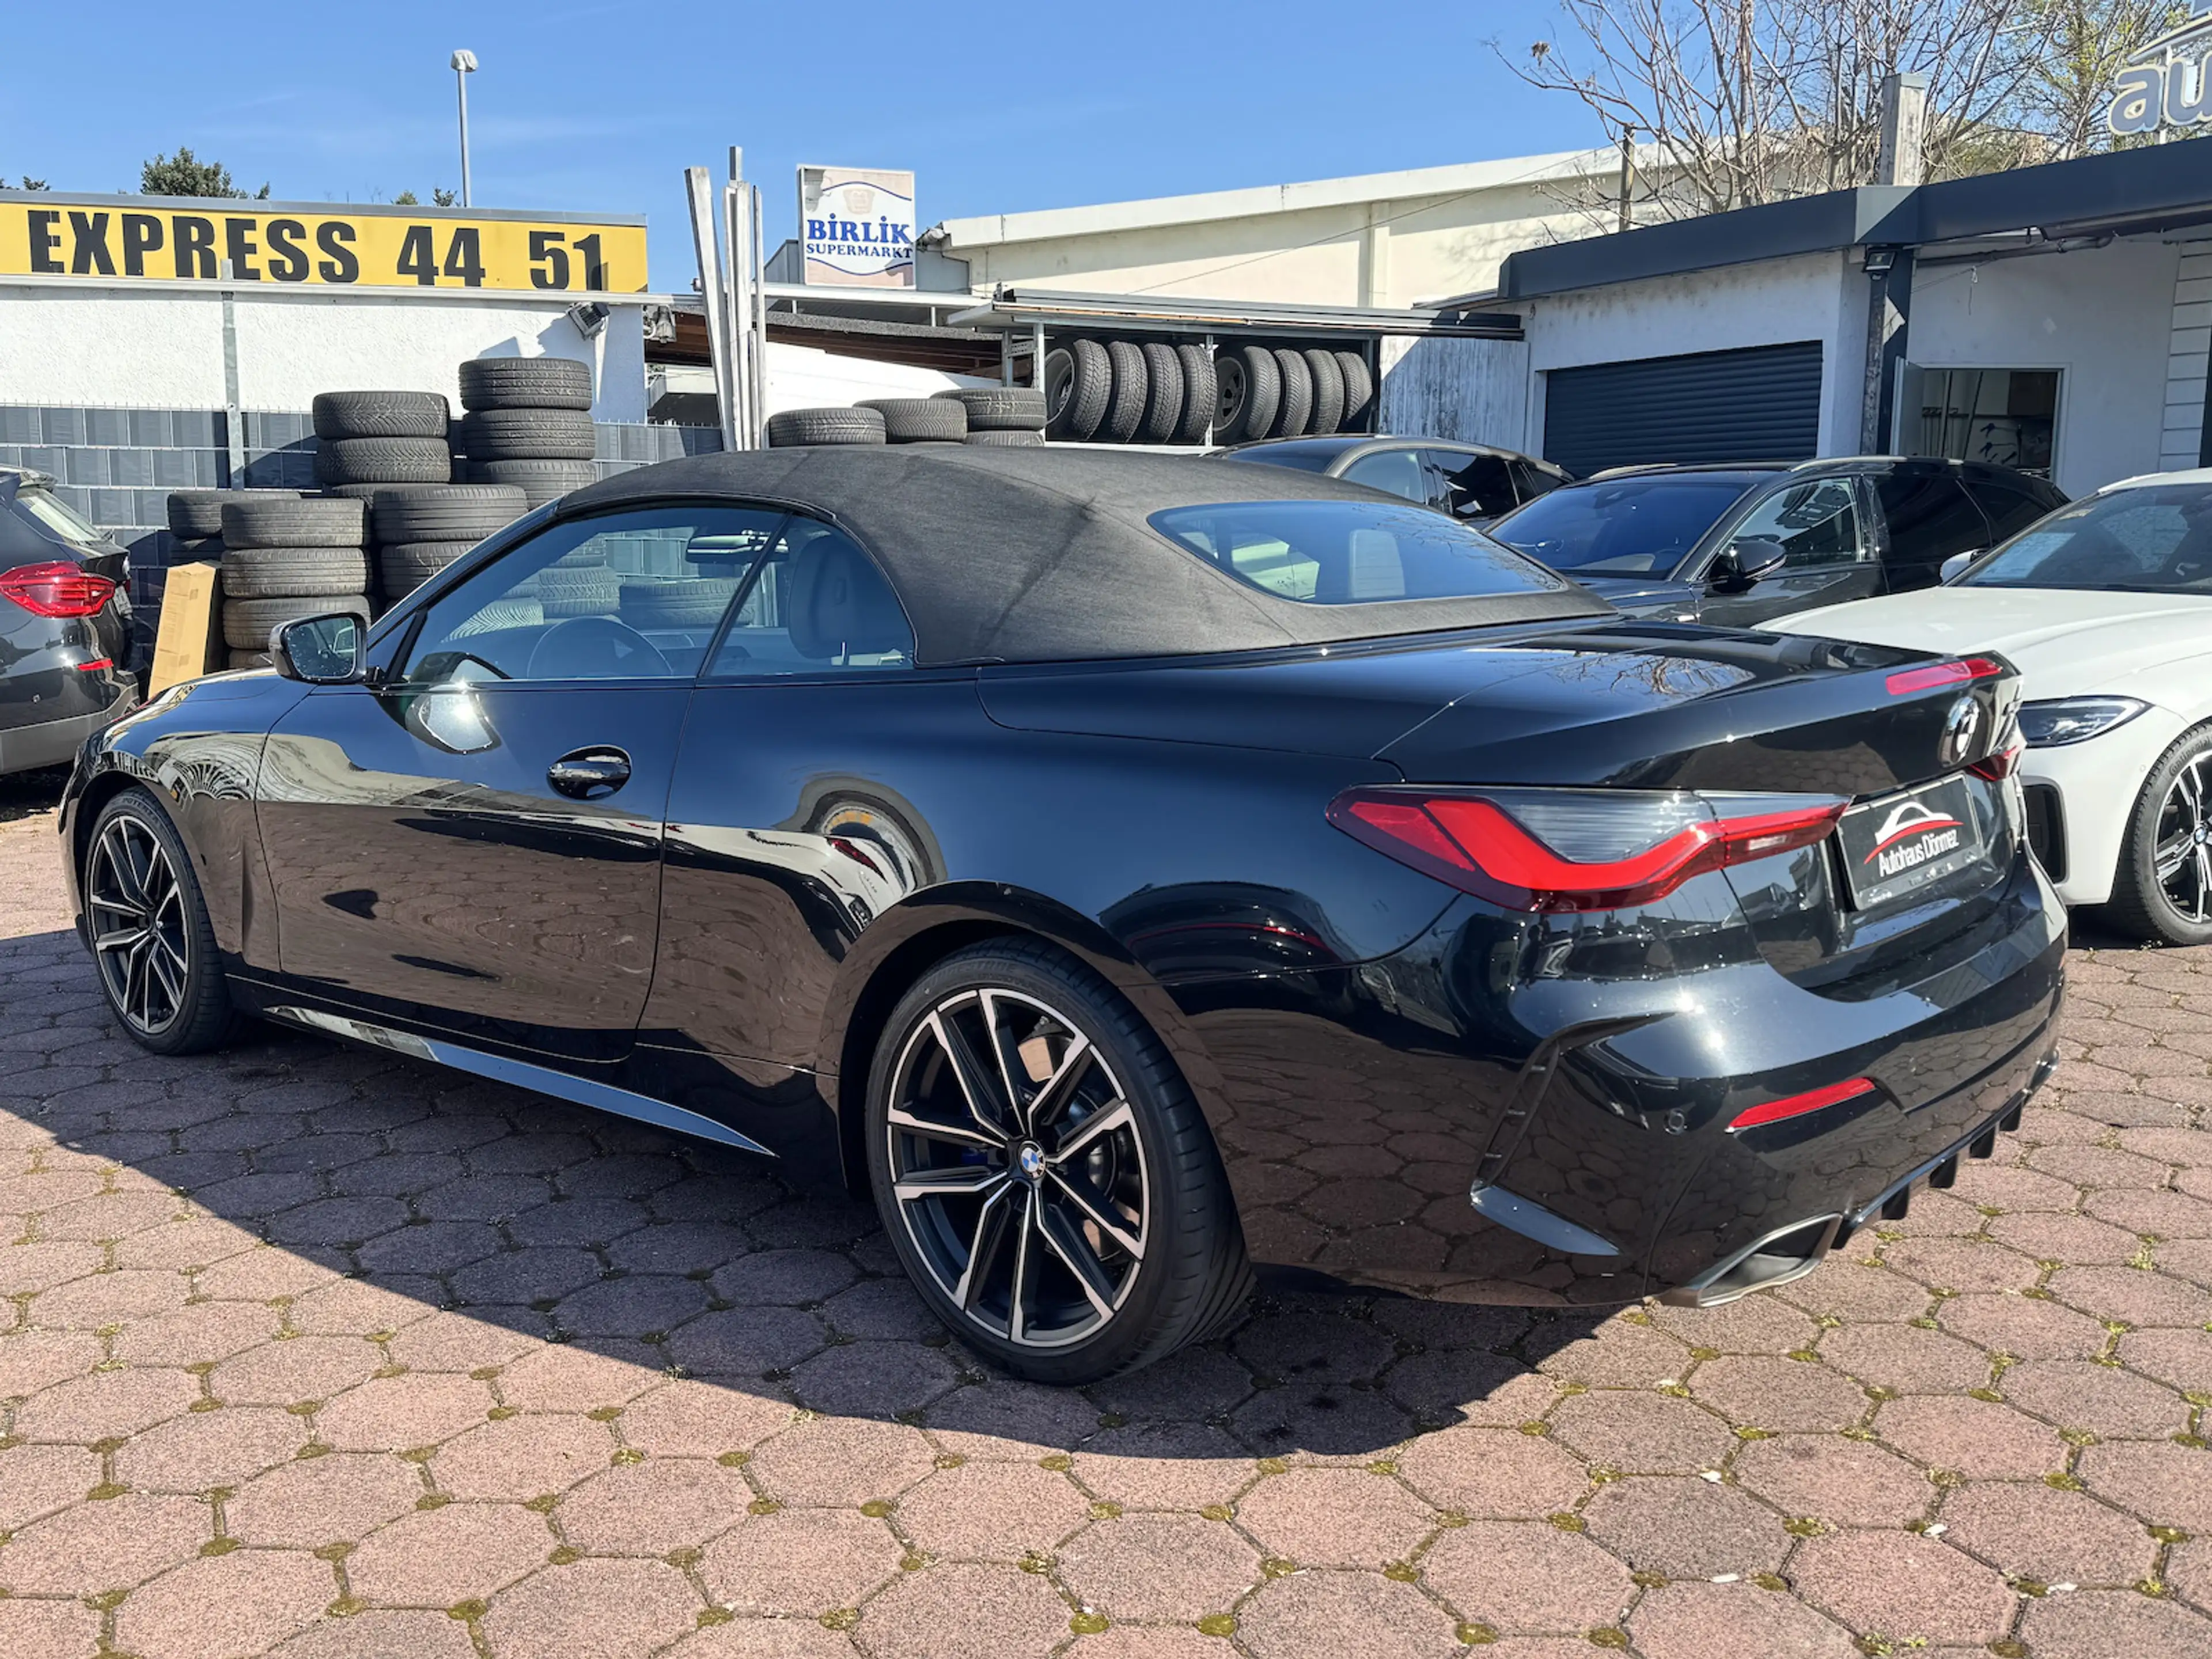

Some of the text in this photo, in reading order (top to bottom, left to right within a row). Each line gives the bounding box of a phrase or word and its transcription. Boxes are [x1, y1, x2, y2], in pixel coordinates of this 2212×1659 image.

[27, 209, 603, 291] EXPRESS 44 51
[806, 244, 913, 258] SUPERMARKT
[1878, 843, 1925, 877] Autohaus
